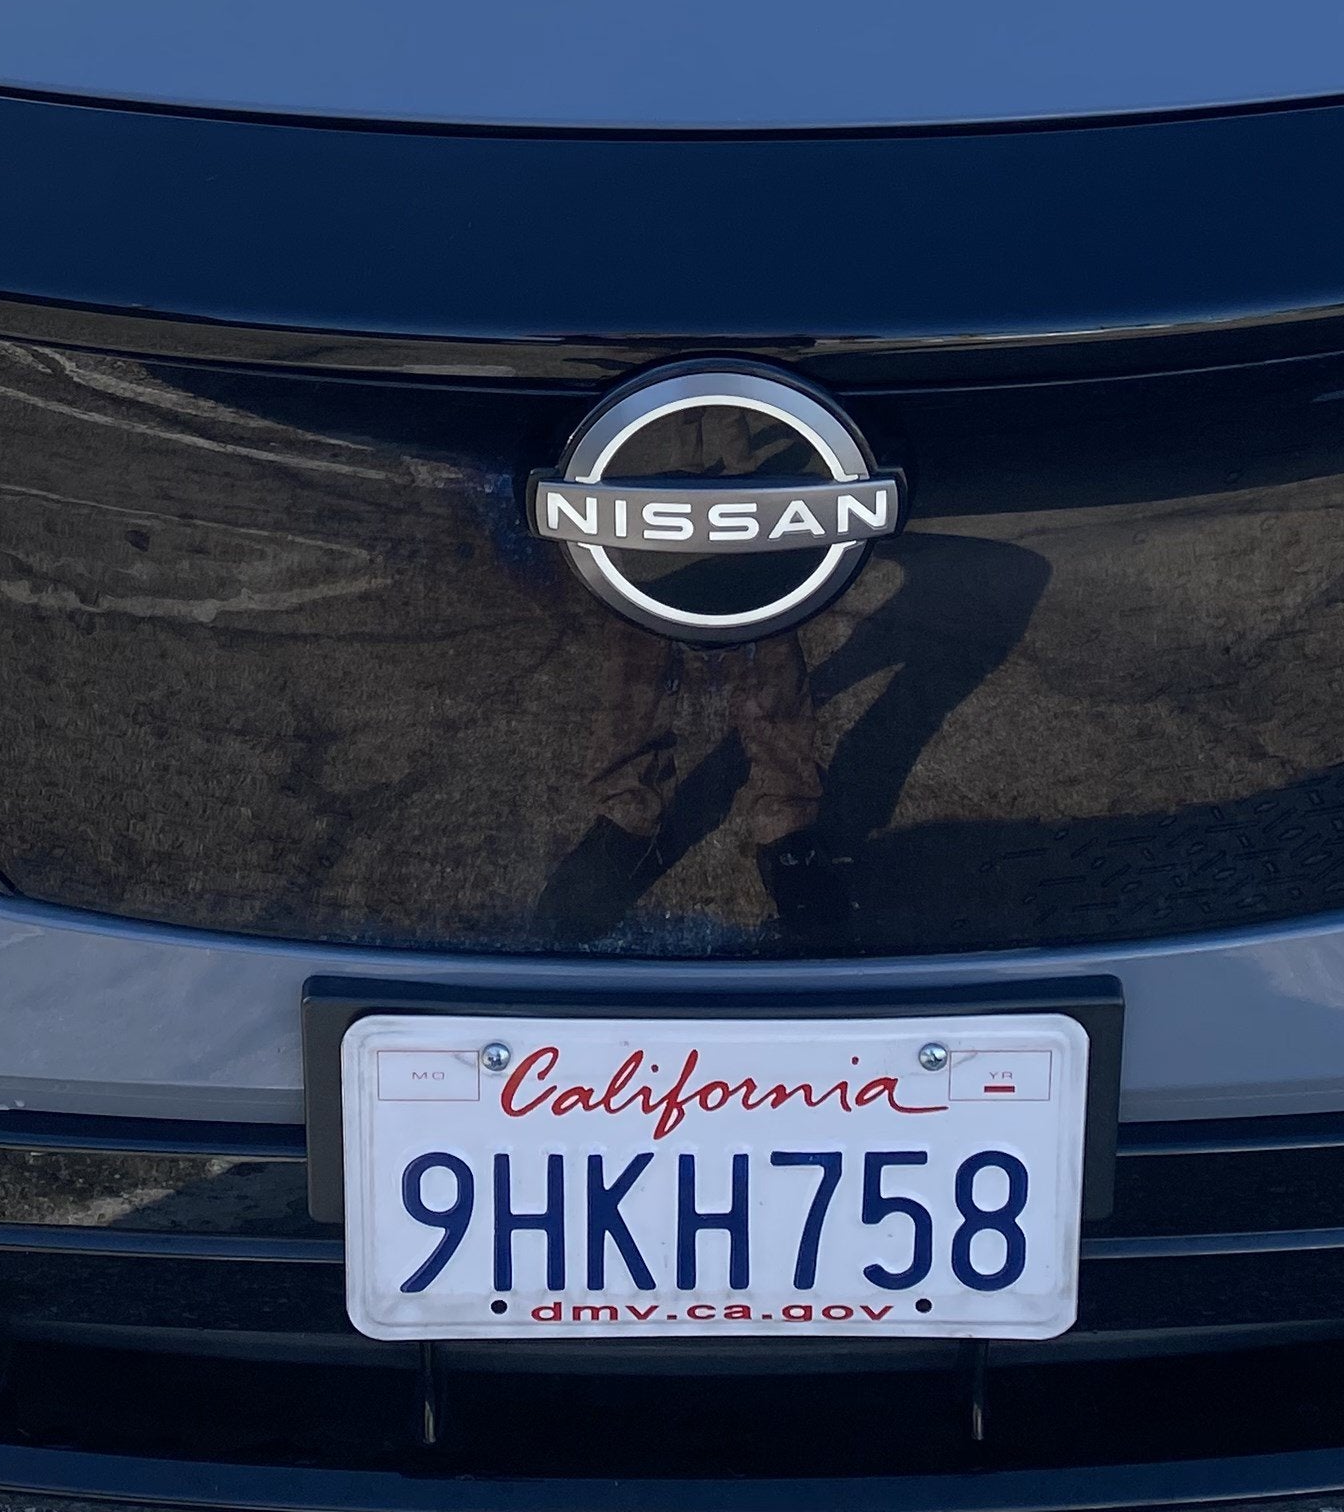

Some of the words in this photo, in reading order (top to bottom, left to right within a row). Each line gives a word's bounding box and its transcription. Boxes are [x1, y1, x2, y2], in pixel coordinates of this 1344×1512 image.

[546, 490, 888, 542] NISSAN
[411, 1070, 446, 1081] MO
[500, 1046, 950, 1141] California
[987, 1070, 1016, 1080] YR
[399, 1148, 1030, 1293] 9HKH758
[529, 1298, 896, 1324] dmv.ca.gov
